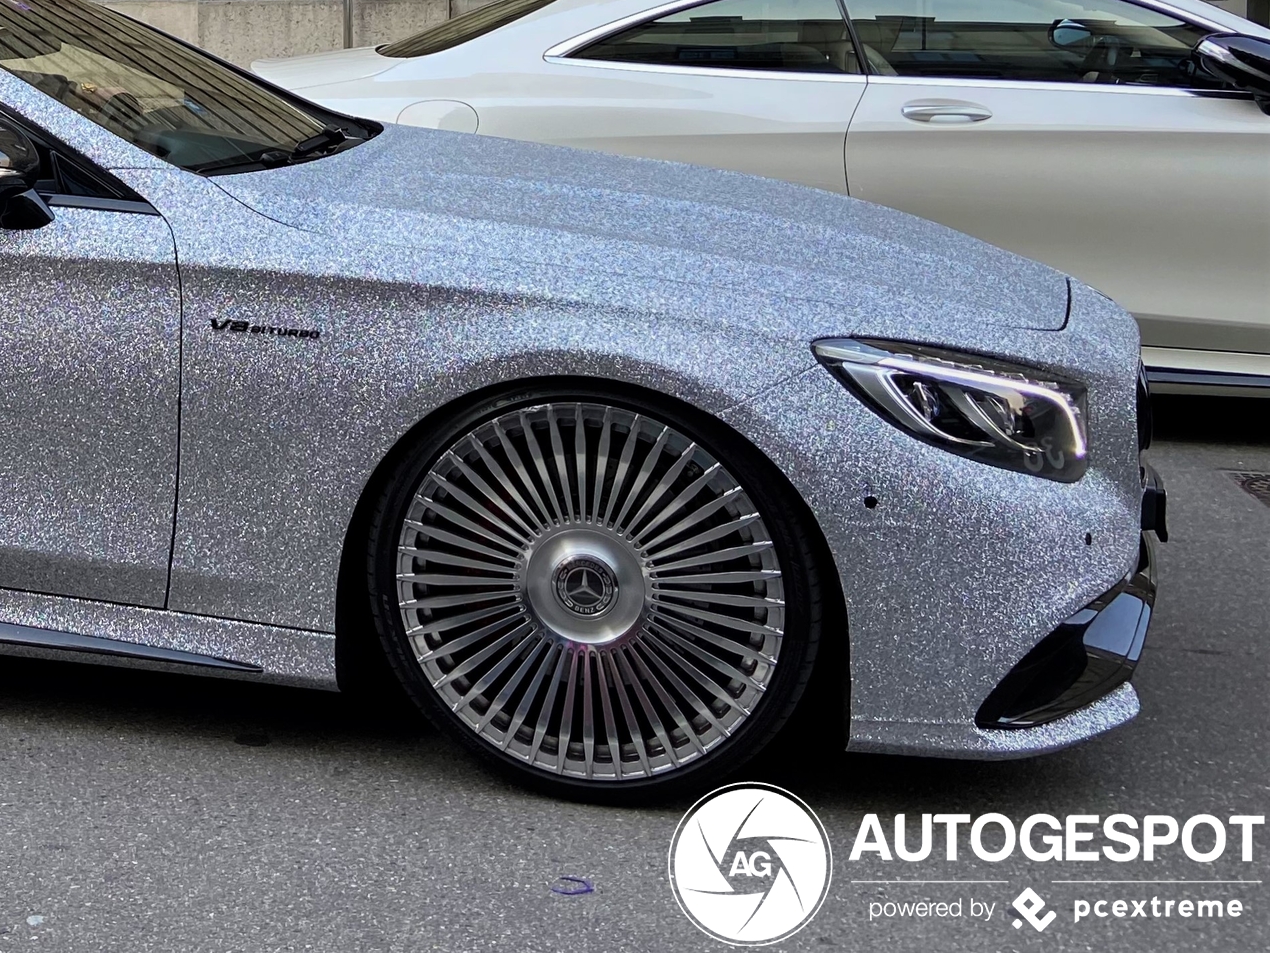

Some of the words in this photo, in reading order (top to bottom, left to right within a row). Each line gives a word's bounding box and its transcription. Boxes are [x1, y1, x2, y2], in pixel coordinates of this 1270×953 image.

[210, 318, 250, 332] V8
[250, 325, 320, 339] BITURBO
[574, 605, 595, 614] BENZ
